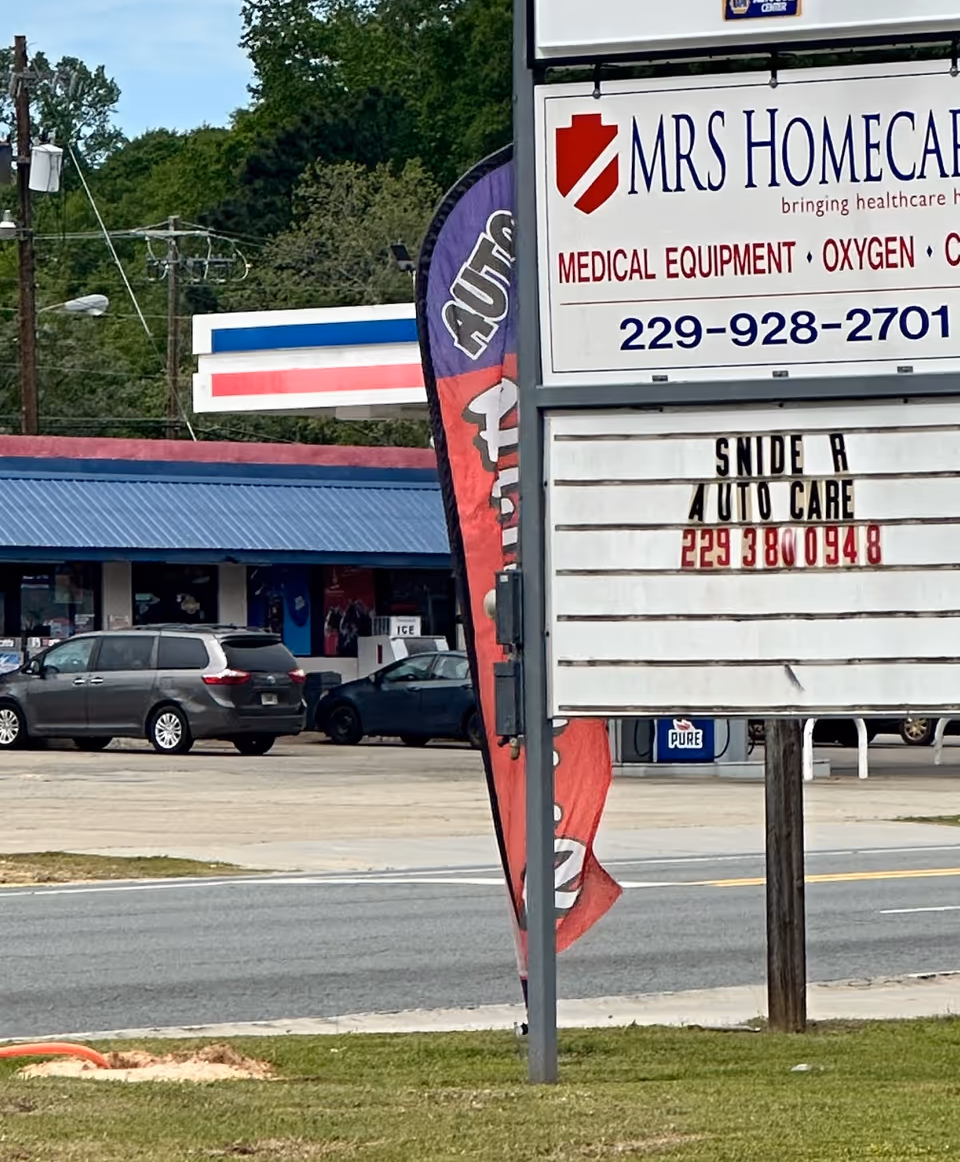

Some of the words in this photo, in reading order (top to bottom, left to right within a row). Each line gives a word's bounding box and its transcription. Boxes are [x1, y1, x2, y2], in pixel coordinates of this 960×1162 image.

[628, 111, 726, 194] MRS
[782, 196, 849, 217] bringing
[856, 191, 946, 210] healthcare
[558, 249, 656, 284] MEDICAL
[665, 241, 796, 280] EQUIPMENT
[823, 236, 915, 272] OXYGEN
[619, 305, 951, 351] 229-928-2701
[688, 481, 771, 521] AUTO
[790, 480, 854, 520] CARE
[682, 528, 730, 567] 229
[397, 625, 415, 635] ICE
[670, 730, 702, 747] PURE
